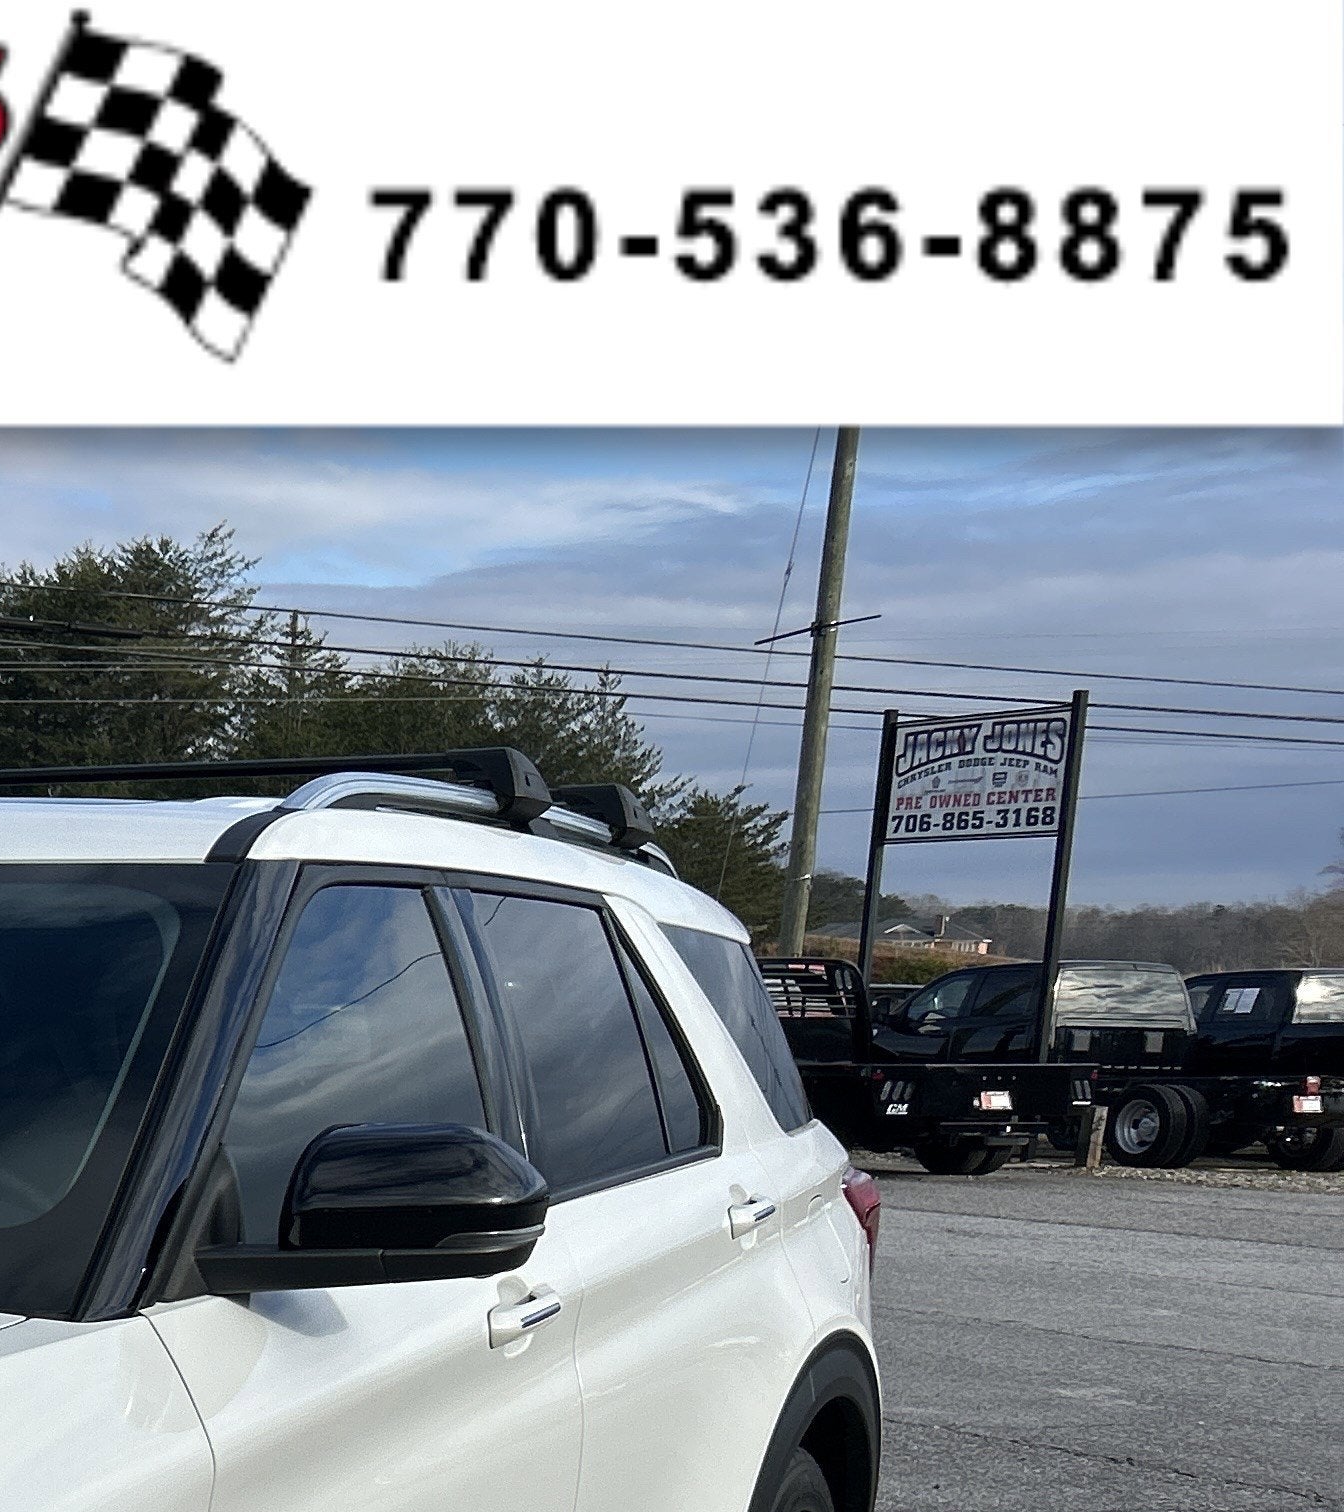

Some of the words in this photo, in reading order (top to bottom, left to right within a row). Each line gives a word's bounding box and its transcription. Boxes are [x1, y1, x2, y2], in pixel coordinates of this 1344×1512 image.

[896, 723, 983, 777] JACKY
[983, 718, 1067, 764] JONES
[897, 762, 952, 789] CHRYSLER
[958, 757, 995, 769] DODGE
[999, 758, 1029, 769] JEEP
[1034, 762, 1058, 778] RAM
[895, 796, 923, 810] PRE
[929, 792, 981, 809] OWNED
[986, 788, 1057, 805] CENTER
[891, 806, 1056, 834] 706-865-3168
